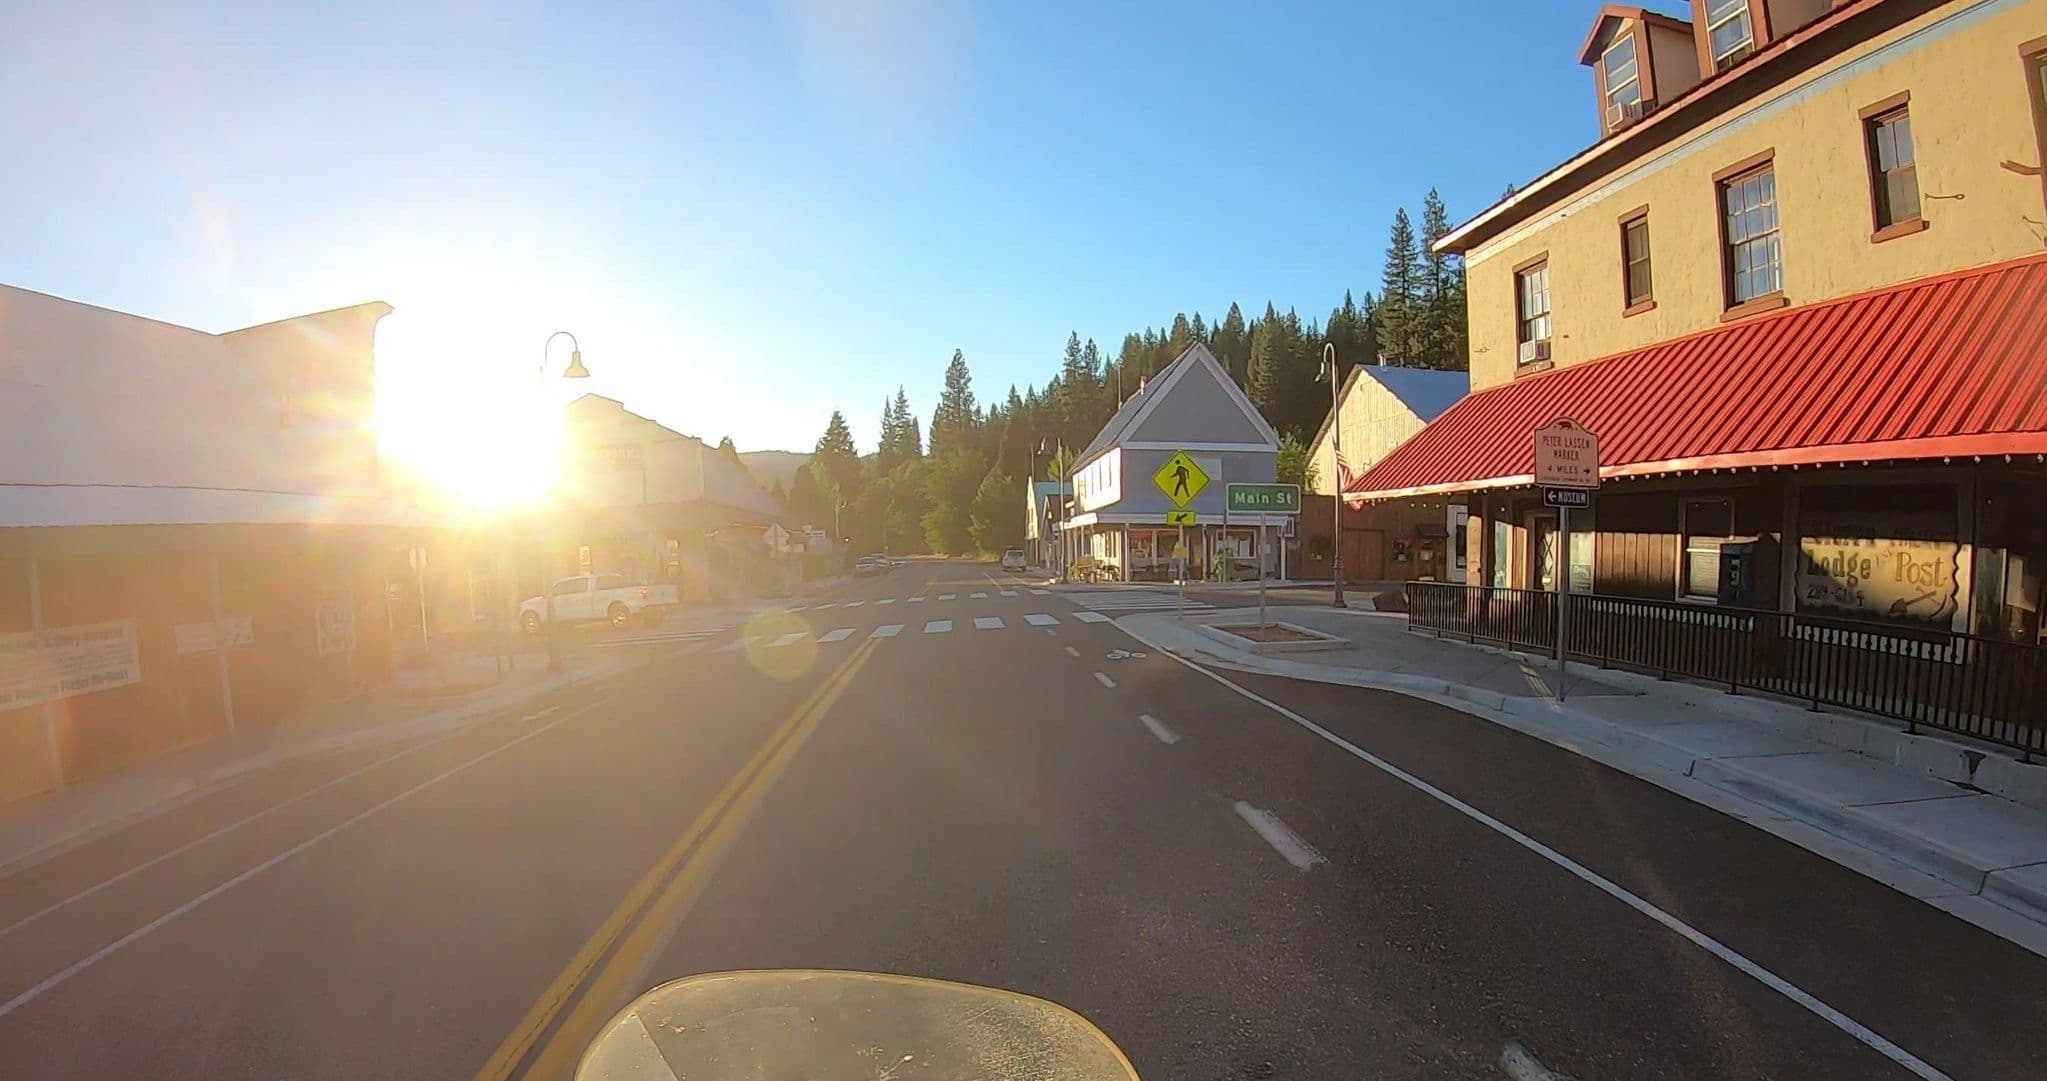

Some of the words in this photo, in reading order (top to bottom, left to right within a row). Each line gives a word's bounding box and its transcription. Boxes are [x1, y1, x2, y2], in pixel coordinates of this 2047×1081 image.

[1542, 436, 1561, 447] PETER
[1565, 437, 1590, 449] LASSEN
[1553, 450, 1579, 460] MARKER
[1557, 466, 1578, 474] MILES
[1234, 491, 1270, 504] Main
[1276, 492, 1292, 505] St
[1558, 491, 1586, 504] MUSEUM
[1806, 549, 1872, 588] Lodge
[1895, 551, 1947, 588] Post
